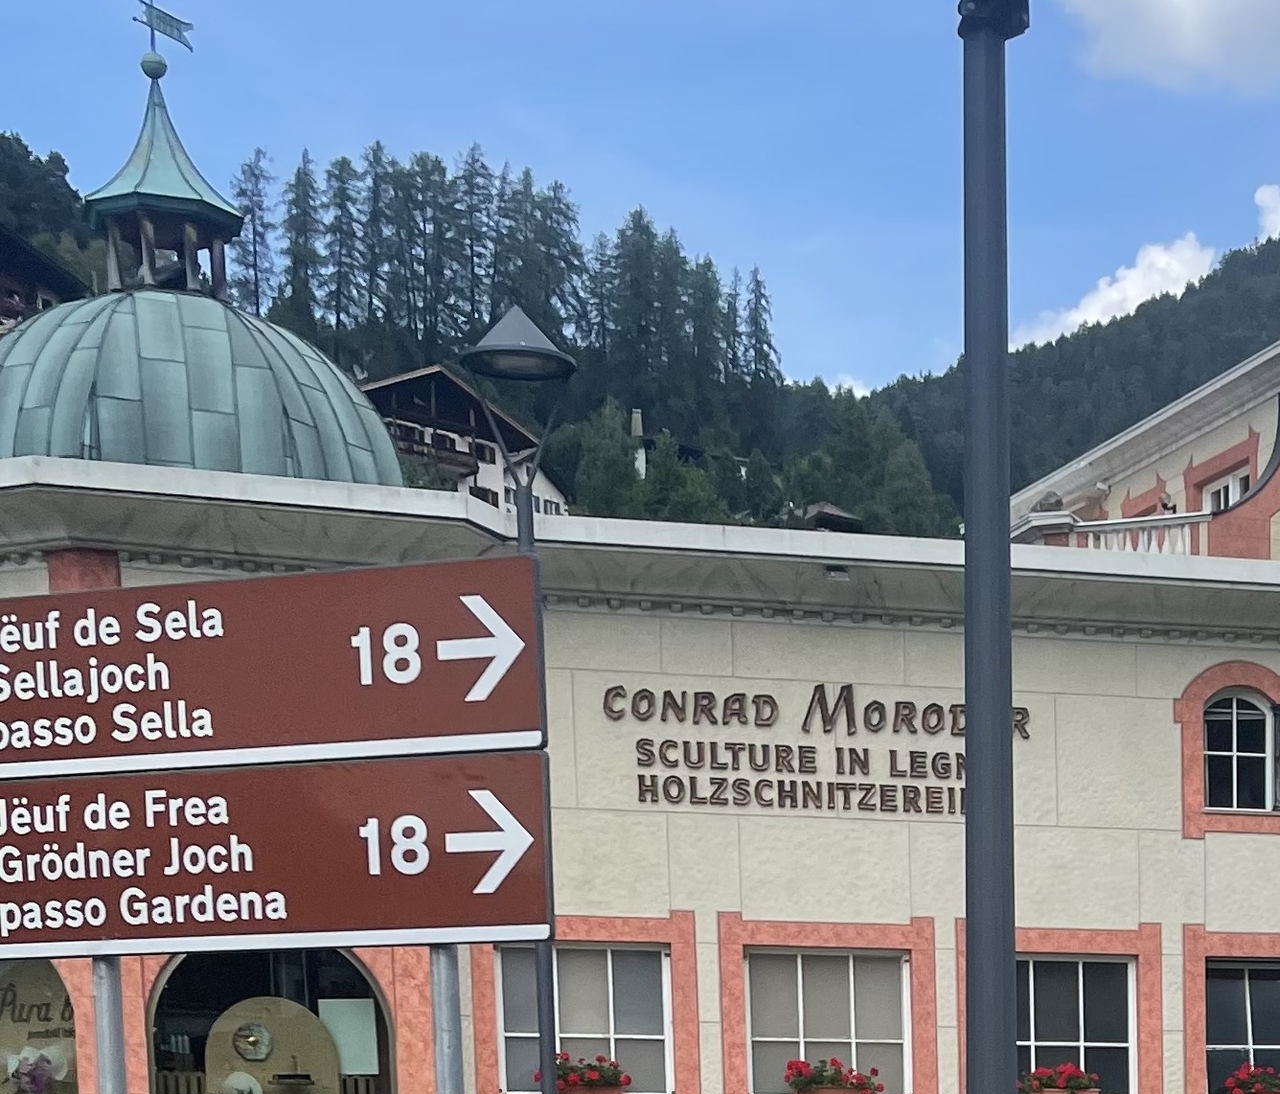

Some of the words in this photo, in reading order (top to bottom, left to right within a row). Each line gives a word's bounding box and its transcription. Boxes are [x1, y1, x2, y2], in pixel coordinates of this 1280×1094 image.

[73, 608, 120, 647] de
[135, 600, 224, 642] Sela
[351, 622, 422, 686] 18
[112, 700, 214, 743] Sella
[602, 685, 779, 728] CONRAD
[801, 683, 1030, 739] MORODR
[635, 738, 817, 773] SCULTURE
[835, 747, 870, 776] IN
[889, 749, 966, 780] LEGN
[84, 792, 131, 831] de
[144, 789, 229, 828] Frea
[637, 774, 966, 814] HOLZSCHNITZEREI
[0, 842, 151, 882] Grödner
[163, 835, 254, 877] Joch
[358, 814, 430, 876] 18
[0, 897, 106, 938] passo
[120, 884, 287, 926] Gardena
